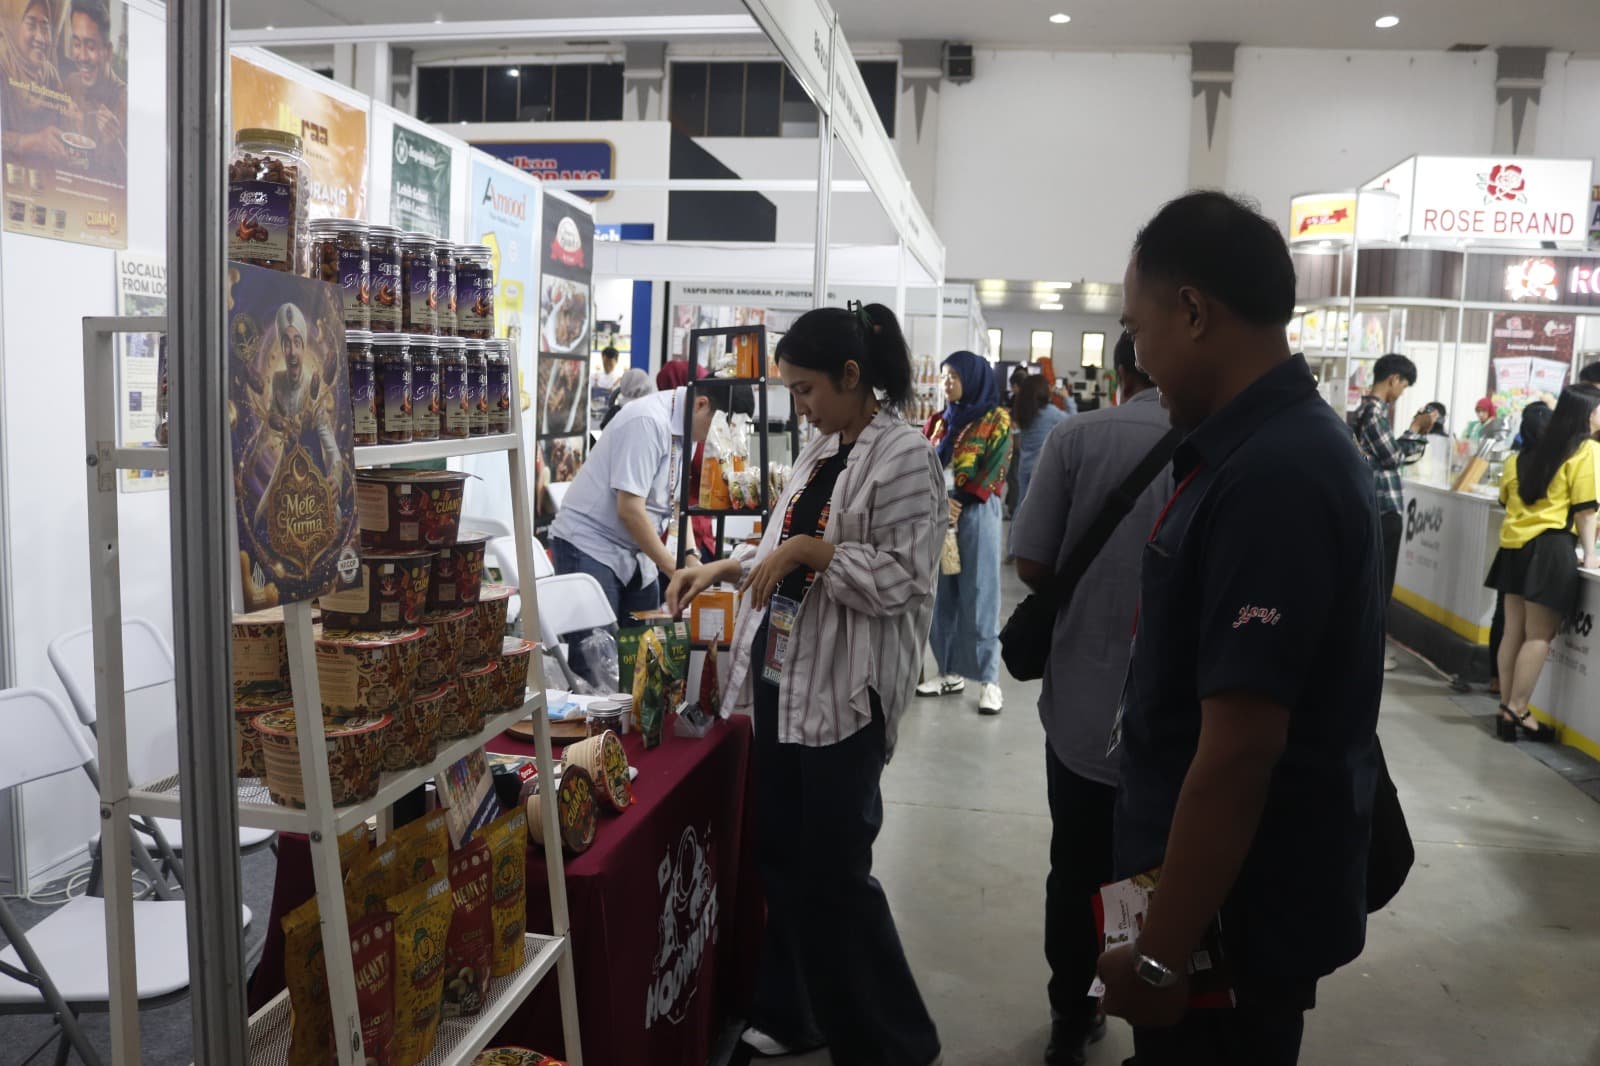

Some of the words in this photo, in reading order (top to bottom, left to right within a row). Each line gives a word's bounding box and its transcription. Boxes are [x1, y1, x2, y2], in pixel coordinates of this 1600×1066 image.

[1424, 209, 1486, 233] ROSE
[1494, 211, 1575, 235] BRAND
[122, 277, 150, 293] FROM
[285, 492, 317, 519] Mete
[282, 516, 323, 537] Kurma
